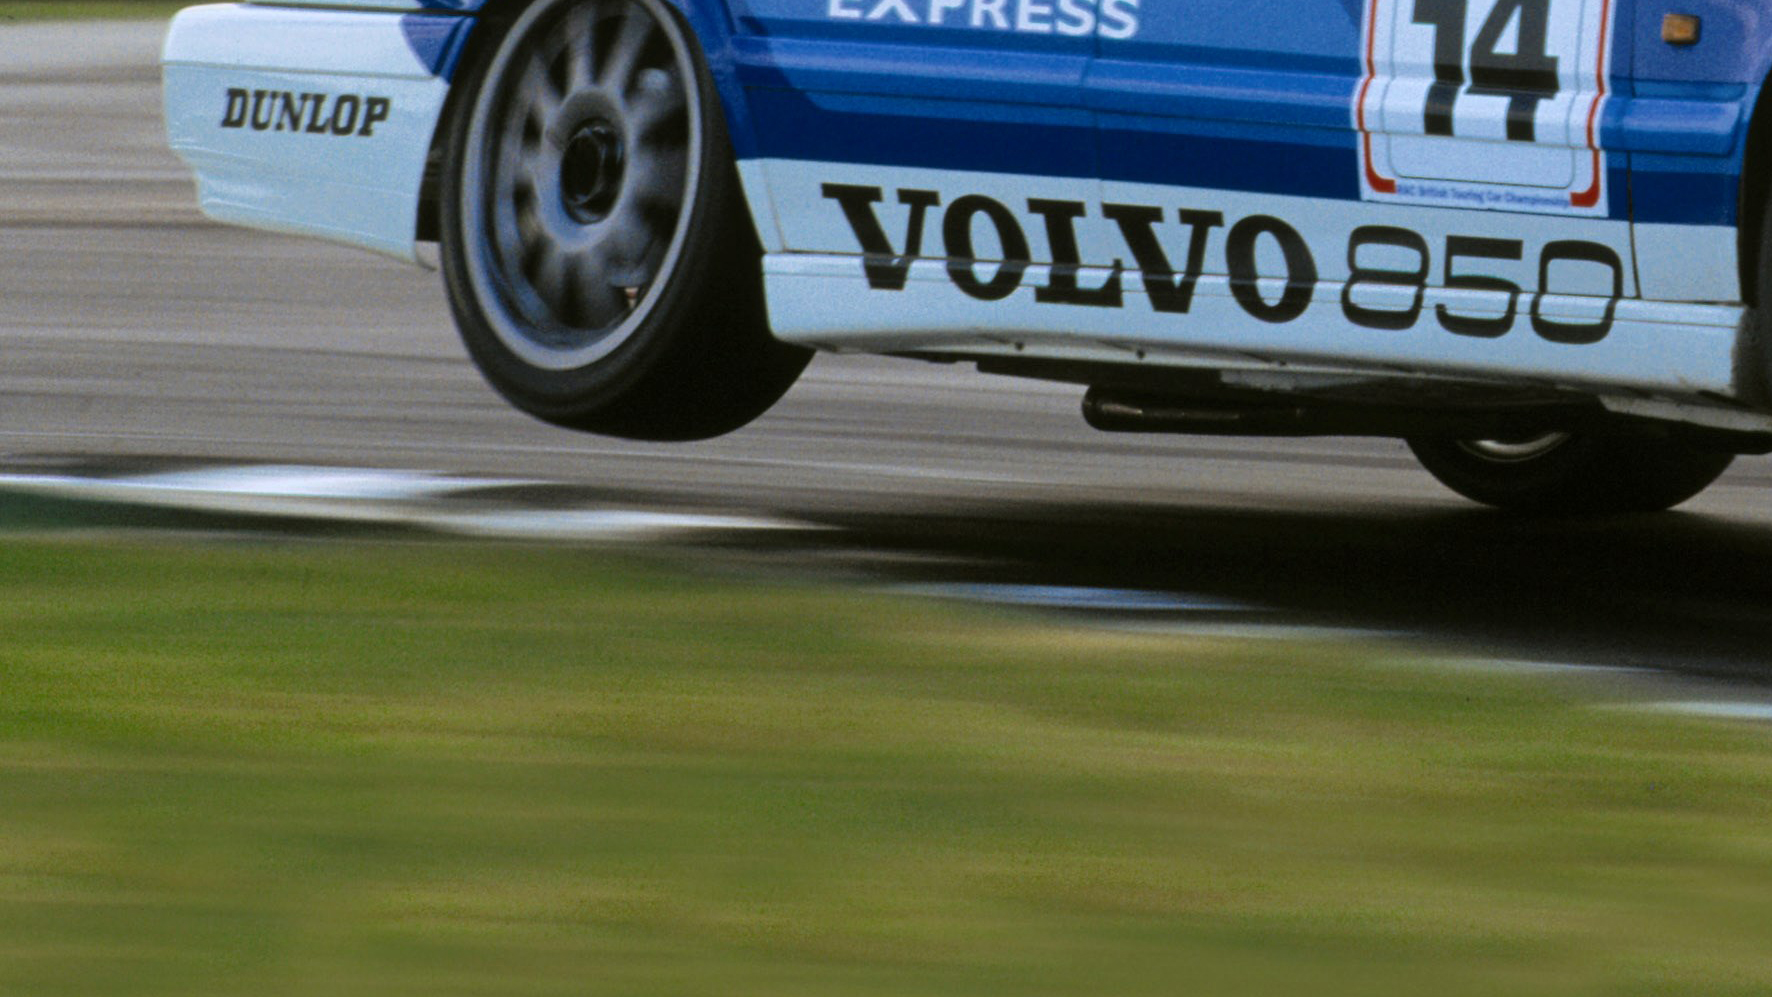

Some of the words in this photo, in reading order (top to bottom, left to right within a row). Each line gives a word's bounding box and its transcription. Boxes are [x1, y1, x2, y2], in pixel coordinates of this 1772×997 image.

[221, 88, 391, 137] DUNLOP
[820, 182, 1319, 325] VOLVO
[1340, 224, 1624, 345] 850
